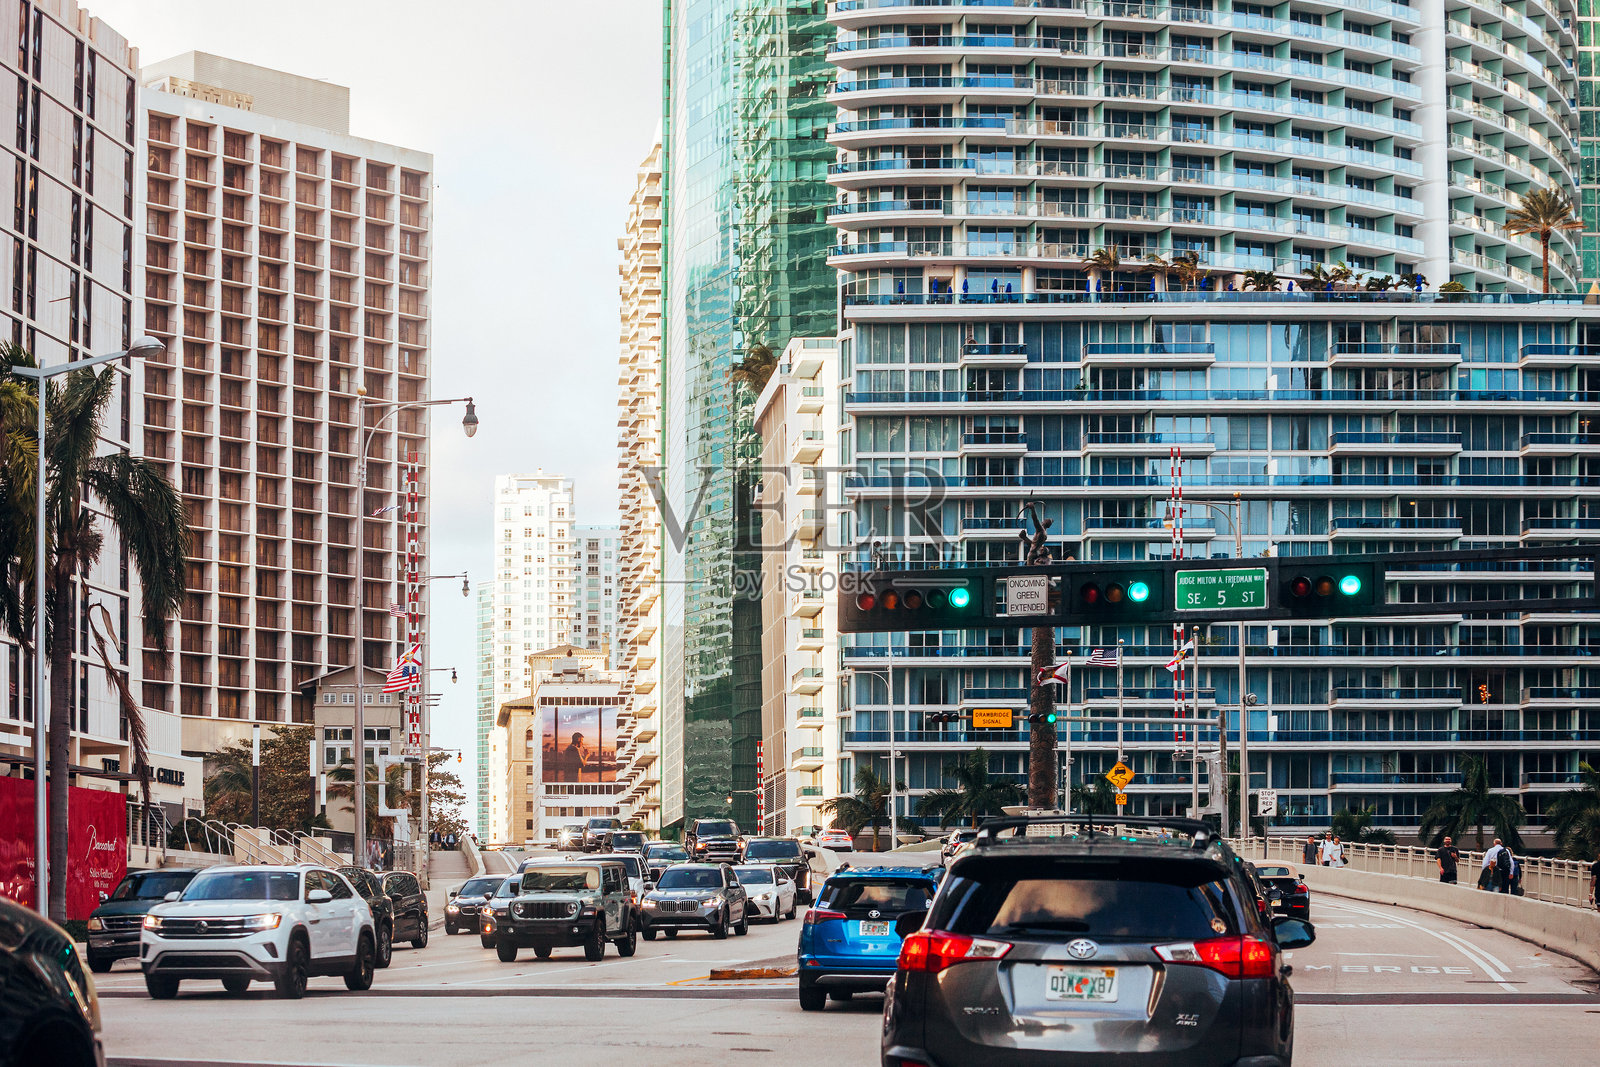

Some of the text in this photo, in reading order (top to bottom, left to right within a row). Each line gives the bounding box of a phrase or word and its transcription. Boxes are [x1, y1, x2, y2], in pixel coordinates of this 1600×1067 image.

[1009, 578, 1046, 588] ONCOMING
[1179, 576, 1195, 585] JUDGE
[1196, 576, 1217, 585] MILTON
[1225, 575, 1253, 584] FRIEDMAN
[1016, 591, 1040, 600] GREEN
[1187, 590, 1255, 605] SE 5 ST
[1010, 603, 1046, 612] EXTENDED
[157, 767, 185, 787] GRILLE
[85, 824, 118, 861] Baccarat
[90, 867, 100, 878] Sales
[1304, 964, 1473, 975] MERGE
